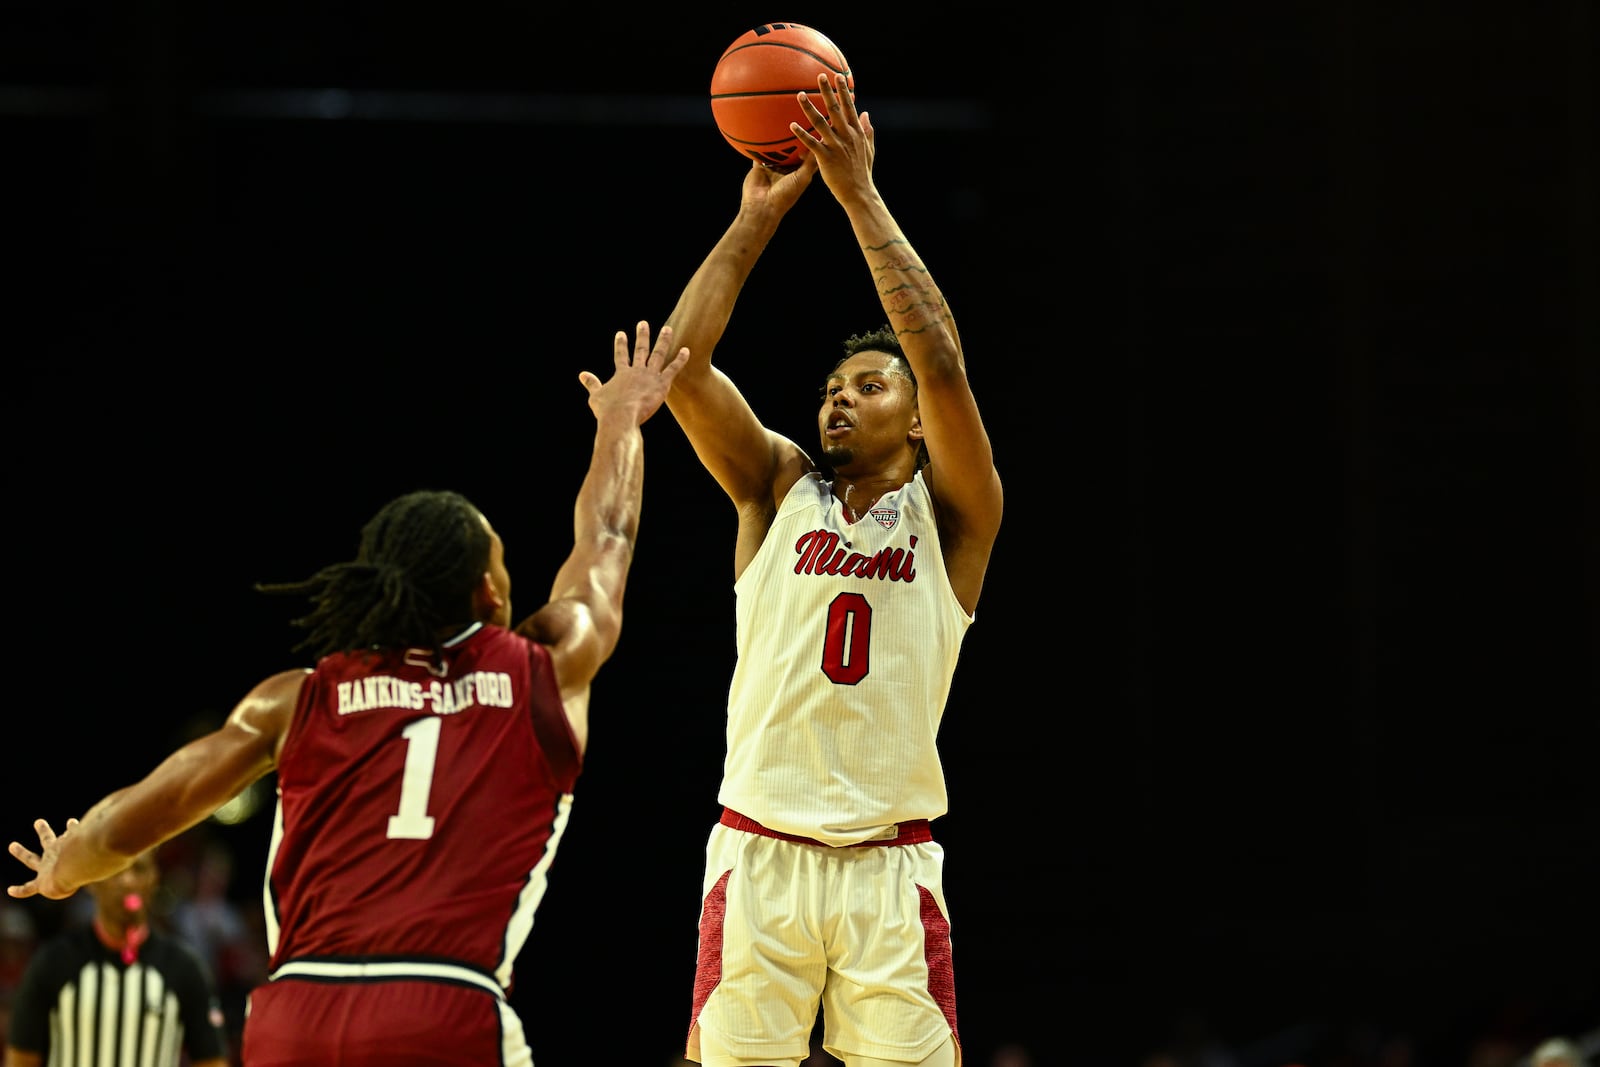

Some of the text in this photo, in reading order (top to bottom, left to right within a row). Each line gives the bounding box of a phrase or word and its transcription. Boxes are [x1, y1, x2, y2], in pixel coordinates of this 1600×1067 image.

[794, 529, 918, 583] Miami
[821, 592, 872, 685] 0
[386, 716, 442, 839] 1
